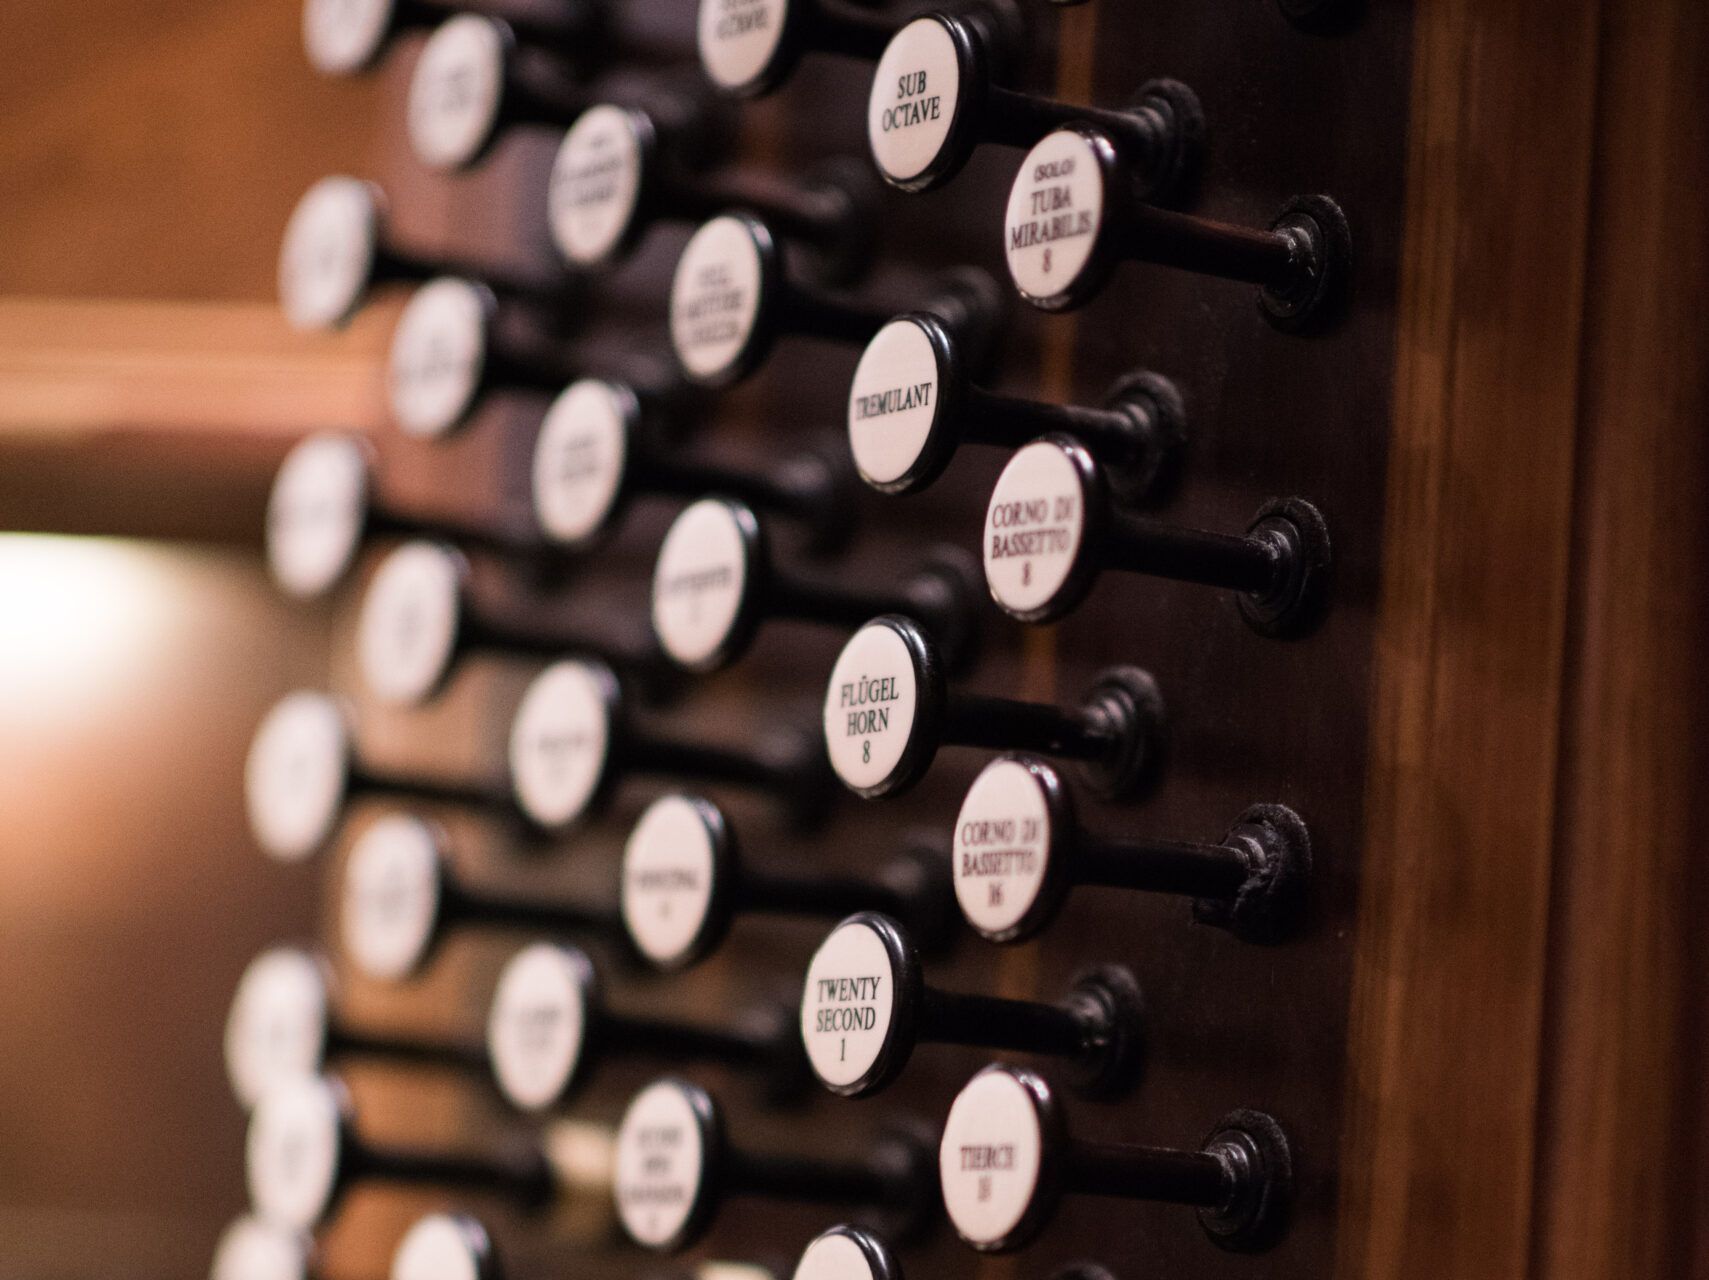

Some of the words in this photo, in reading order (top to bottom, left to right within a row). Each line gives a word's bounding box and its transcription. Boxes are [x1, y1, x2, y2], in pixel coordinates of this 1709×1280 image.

[898, 70, 927, 97] SUB
[883, 95, 940, 131] OCTAVE
[1031, 185, 1071, 213] TUBA
[1010, 209, 1093, 251] MIRABILIS
[855, 382, 933, 421] TREMULANT
[992, 500, 1047, 528] CORNO
[1054, 494, 1074, 520] DI
[991, 525, 1070, 560] BASSETTO
[841, 675, 899, 708] FLÜGEL
[847, 707, 889, 735] HORN
[862, 739, 871, 764] 8
[961, 819, 1014, 845] CORNO
[961, 847, 1035, 877] BASSETTO
[817, 976, 882, 1002] TWENTY
[816, 1006, 876, 1033] SECOND
[839, 1037, 846, 1062] 1
[960, 1143, 1017, 1170] TIERCE
